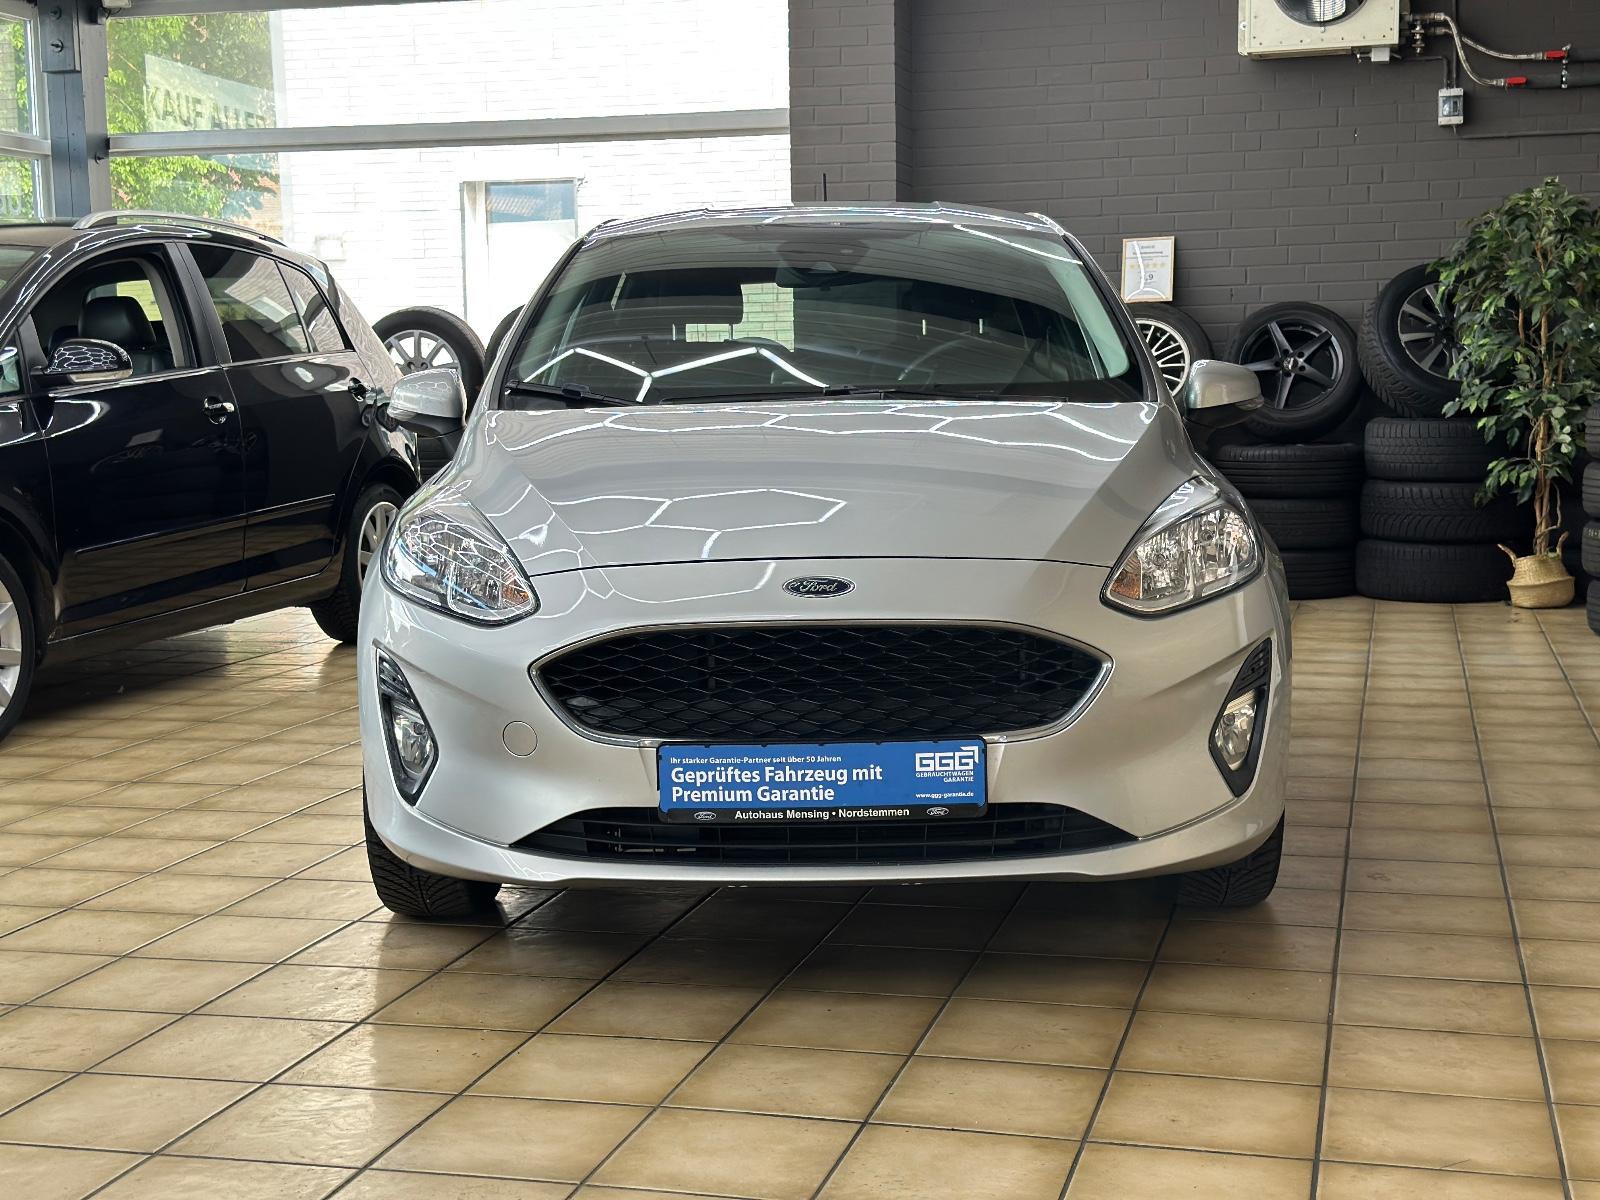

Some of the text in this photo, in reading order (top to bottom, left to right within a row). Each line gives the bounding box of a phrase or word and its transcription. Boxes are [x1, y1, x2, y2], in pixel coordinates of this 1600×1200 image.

[799, 580, 838, 592] Ford
[709, 756, 772, 764] Garantie-Partner
[787, 755, 804, 763] über
[806, 755, 815, 763] 50
[816, 755, 842, 763] Jahren
[915, 751, 974, 772] GGG
[671, 764, 883, 786] Geprüftes Fahrzeug mit
[915, 770, 974, 778] GEBRAUCHTWAGEN
[672, 784, 835, 802] Premium Garantie
[734, 808, 910, 820] Autohaus Mensing Nordstemmen
